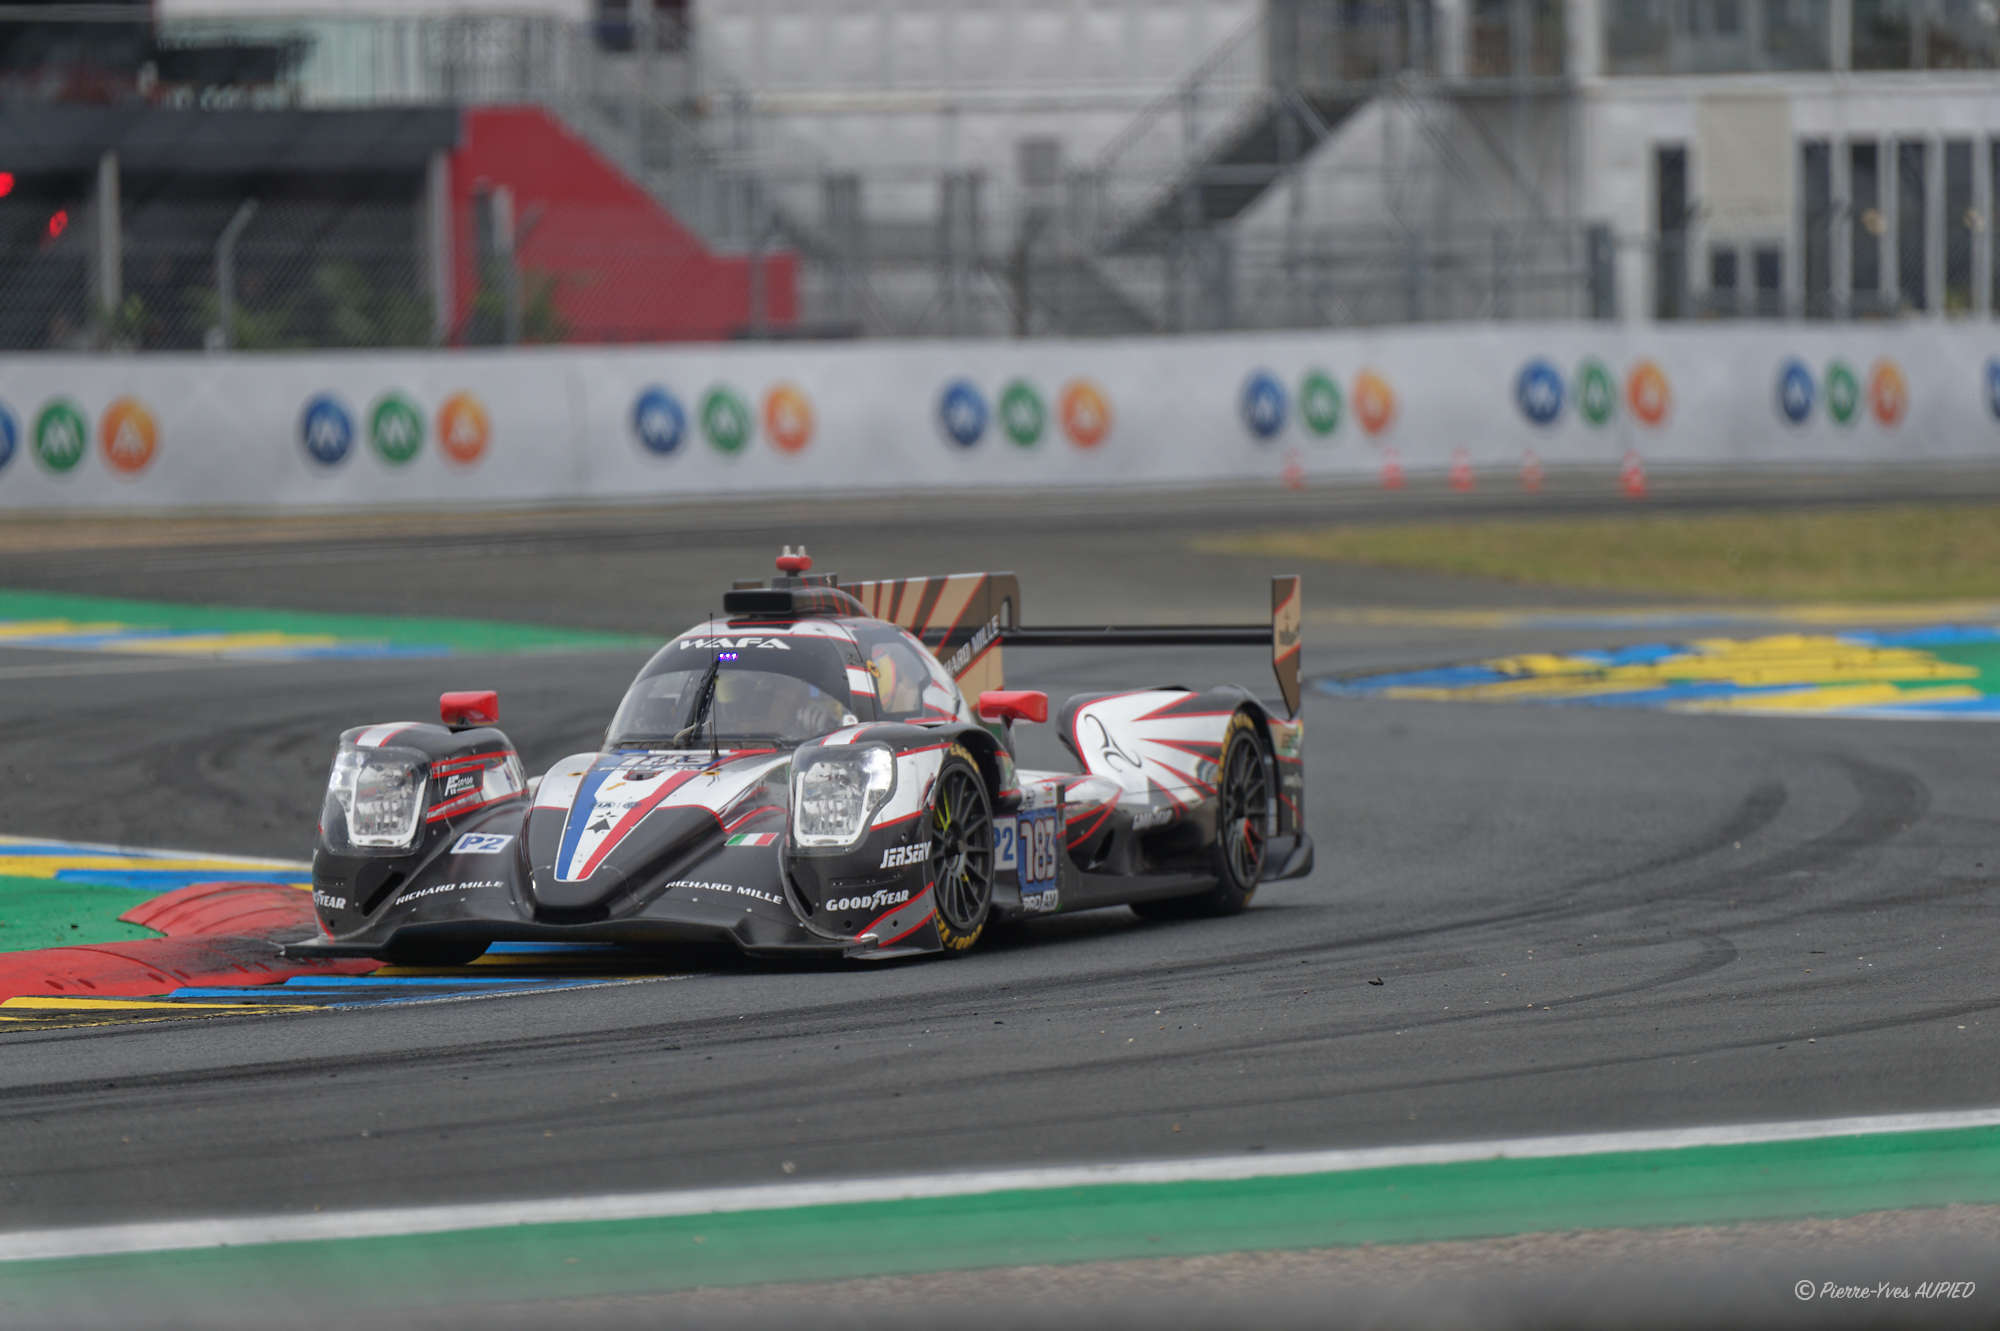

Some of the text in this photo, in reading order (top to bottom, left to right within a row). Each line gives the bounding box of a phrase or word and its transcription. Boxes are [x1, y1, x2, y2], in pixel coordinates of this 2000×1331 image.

[680, 637, 790, 650] WAFA
[458, 836, 504, 850] P2
[880, 840, 932, 869] JERSEY
[1020, 817, 1057, 884] 183
[395, 881, 504, 905] RICHARD MILLE
[665, 880, 783, 905] RICHARD MILLE
[825, 889, 910, 912] GOODYEAR
